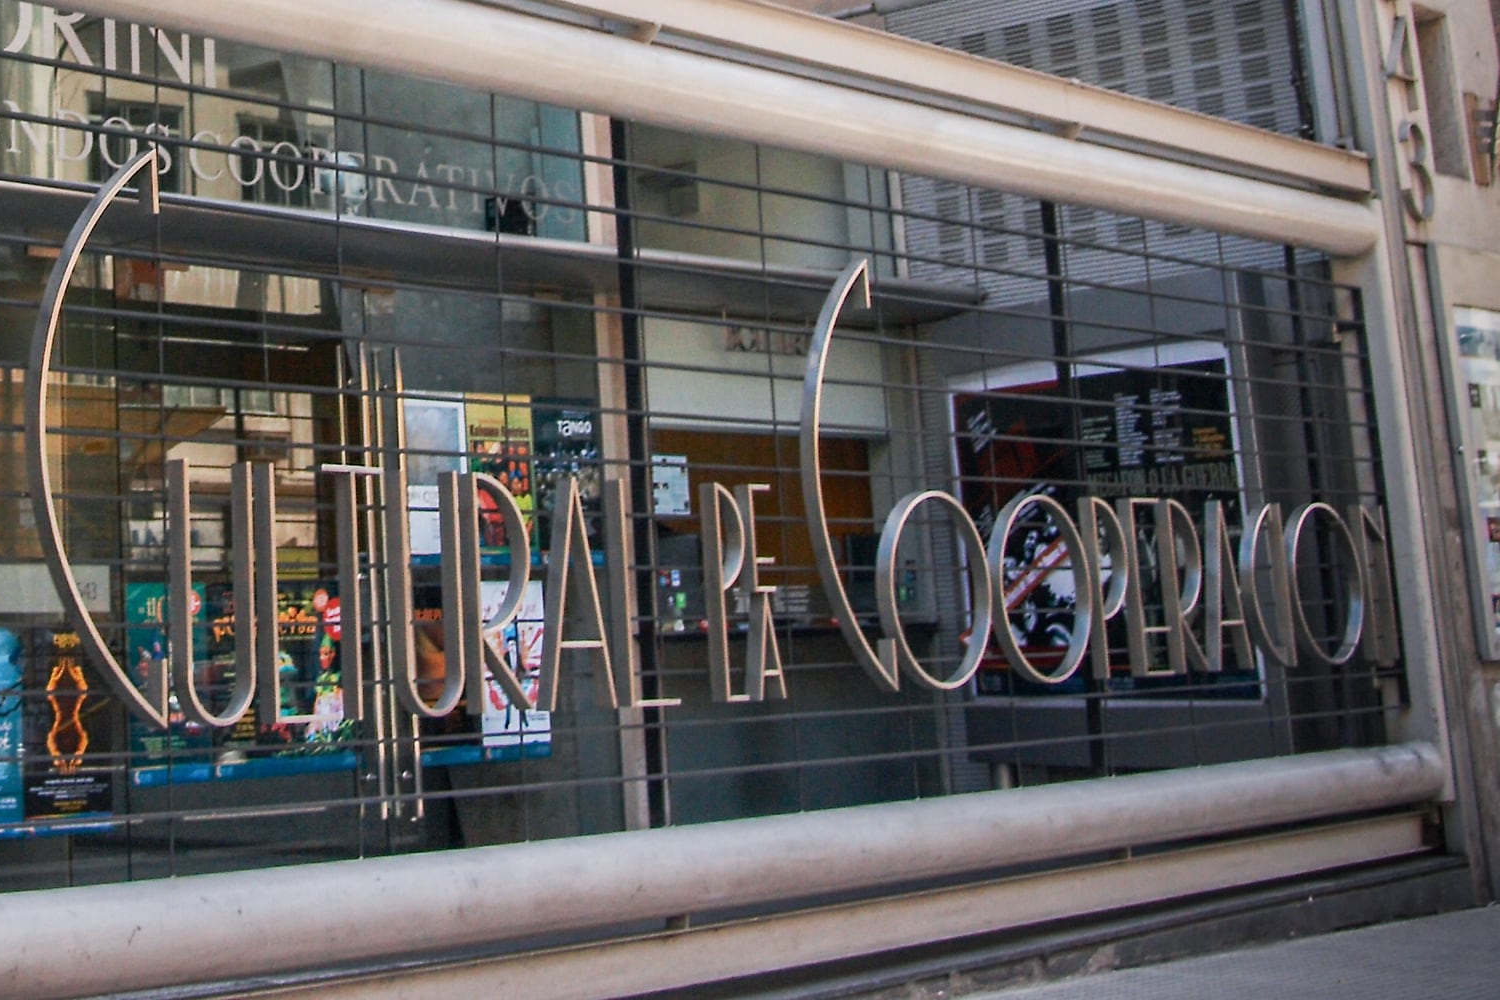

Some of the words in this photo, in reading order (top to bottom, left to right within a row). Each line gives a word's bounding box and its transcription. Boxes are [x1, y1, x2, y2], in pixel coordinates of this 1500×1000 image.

[190, 130, 580, 226] COOPERATIVOS
[33, 147, 683, 735] CULTURAL
[800, 258, 1402, 693] COOPERACION
